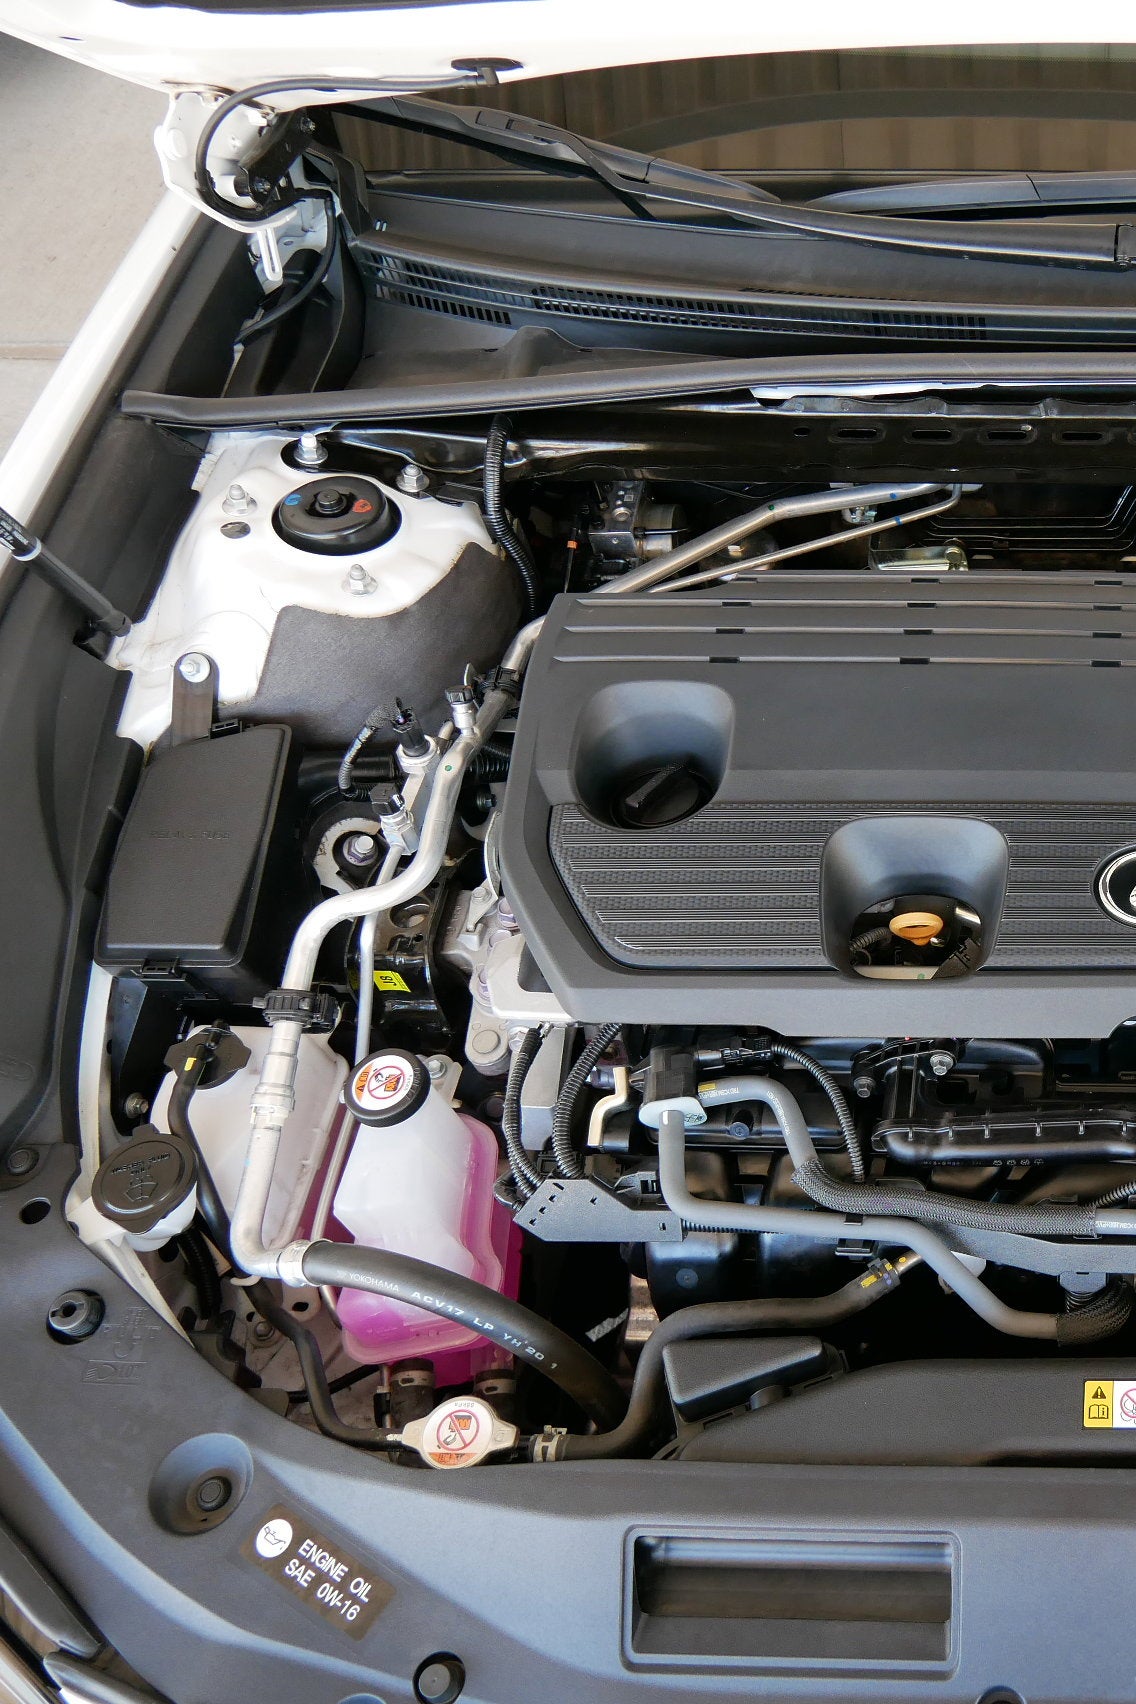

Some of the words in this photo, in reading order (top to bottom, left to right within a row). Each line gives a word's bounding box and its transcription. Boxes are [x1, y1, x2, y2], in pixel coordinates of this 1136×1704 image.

[350, 1272, 399, 1292] YOKOHAMA
[411, 1290, 465, 1316] ACV17
[473, 1317, 495, 1331] LP
[502, 1332, 522, 1348] YH
[525, 1345, 545, 1361] 20
[284, 1558, 316, 1588] SAE
[316, 1582, 361, 1621] 0W-16
[298, 1538, 349, 1582] ENGINE
[350, 1577, 372, 1603] OIL
